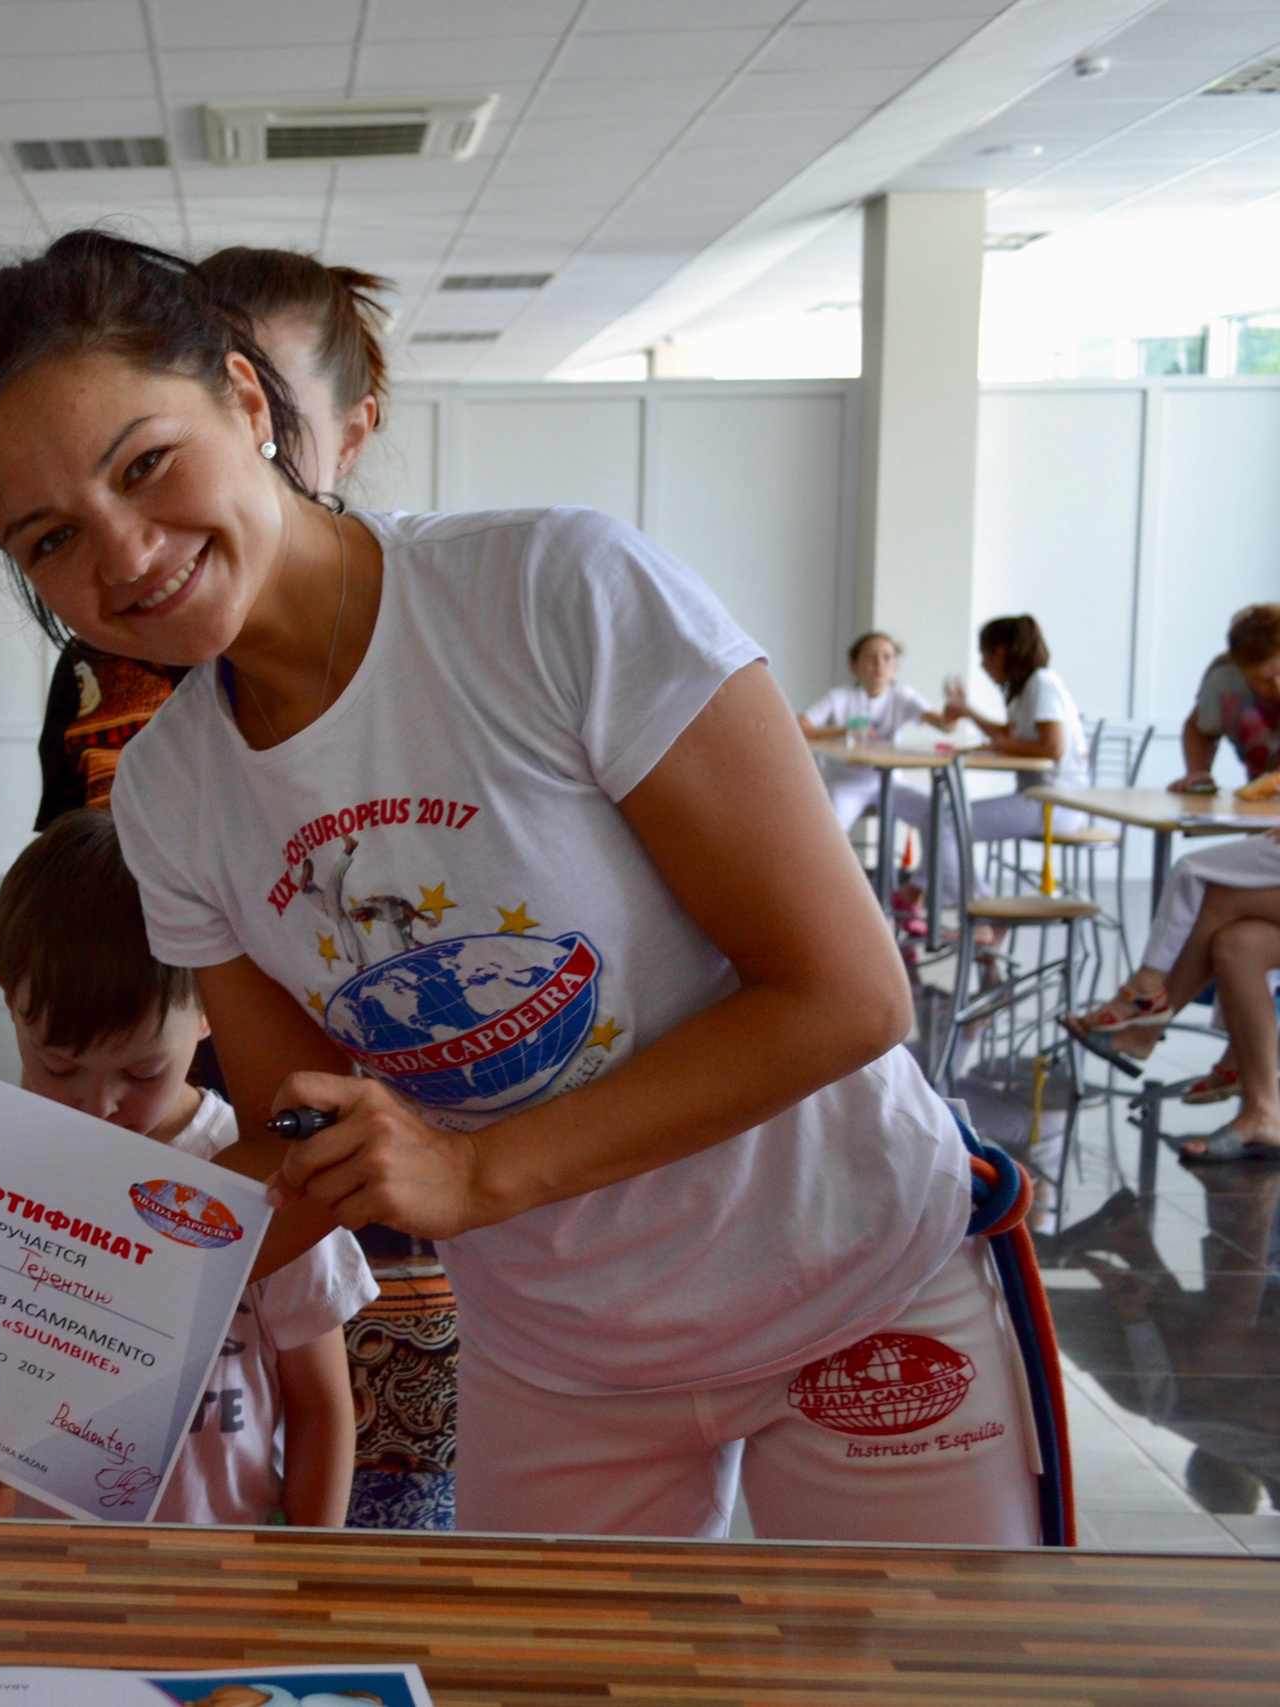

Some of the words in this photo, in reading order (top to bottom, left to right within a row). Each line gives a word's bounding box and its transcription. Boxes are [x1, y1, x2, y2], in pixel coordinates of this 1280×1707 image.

[267, 870, 299, 917] XIX
[298, 797, 411, 851] EUROPEUS
[416, 797, 480, 829] 2017
[362, 970, 587, 1075] BADÁ-CAPOEIRA
[1, 1317, 121, 1376] «SUUMBIKE»
[12, 1298, 156, 1368] ACAMPAMENTO
[17, 1361, 56, 1382] 2017
[17, 1453, 50, 1474] KAZAN
[845, 1442, 929, 1457] Instrutor
[934, 1422, 1005, 1451] Esquilão
